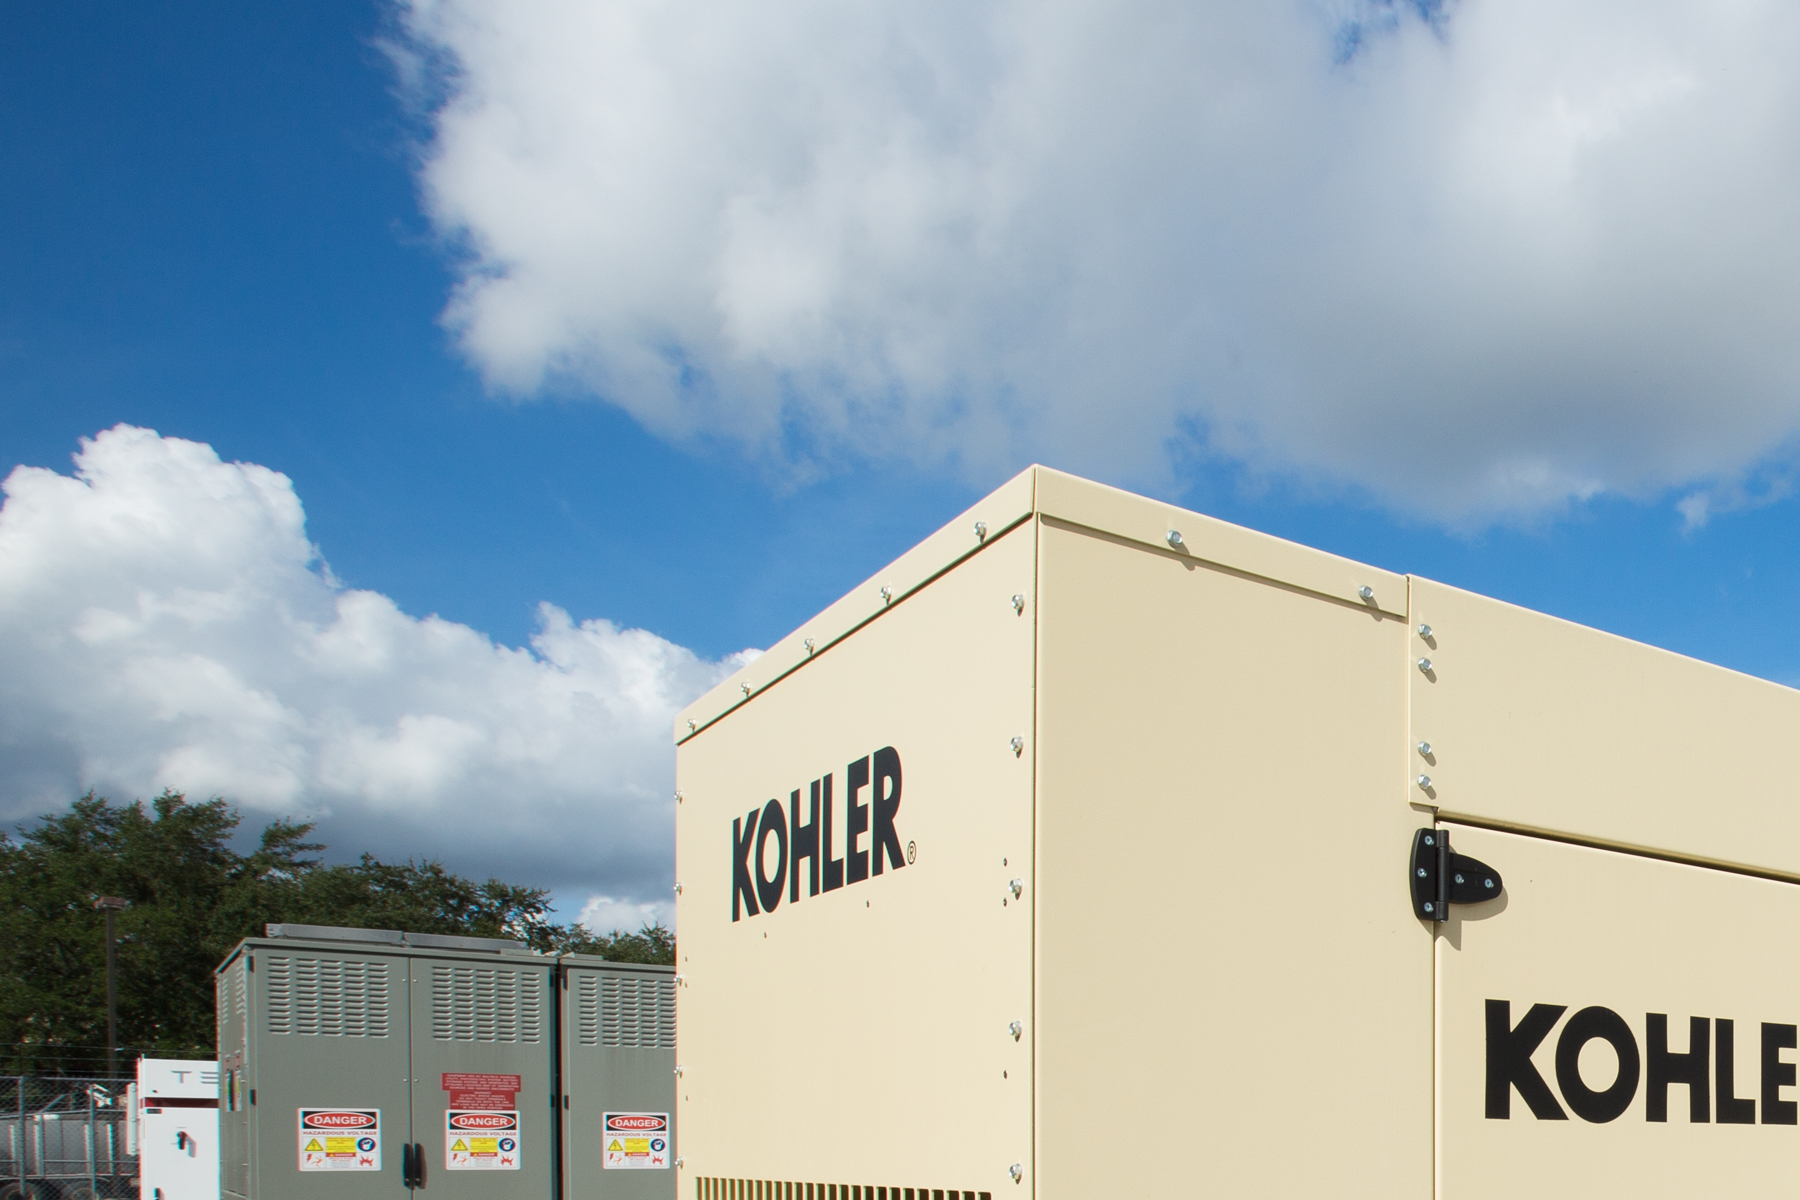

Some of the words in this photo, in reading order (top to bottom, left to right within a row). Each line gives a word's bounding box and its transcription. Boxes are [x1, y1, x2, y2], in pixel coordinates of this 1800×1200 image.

[314, 1116, 367, 1125] DANGER
[460, 1117, 508, 1126] DANGER
[615, 1119, 659, 1127] DANGER
